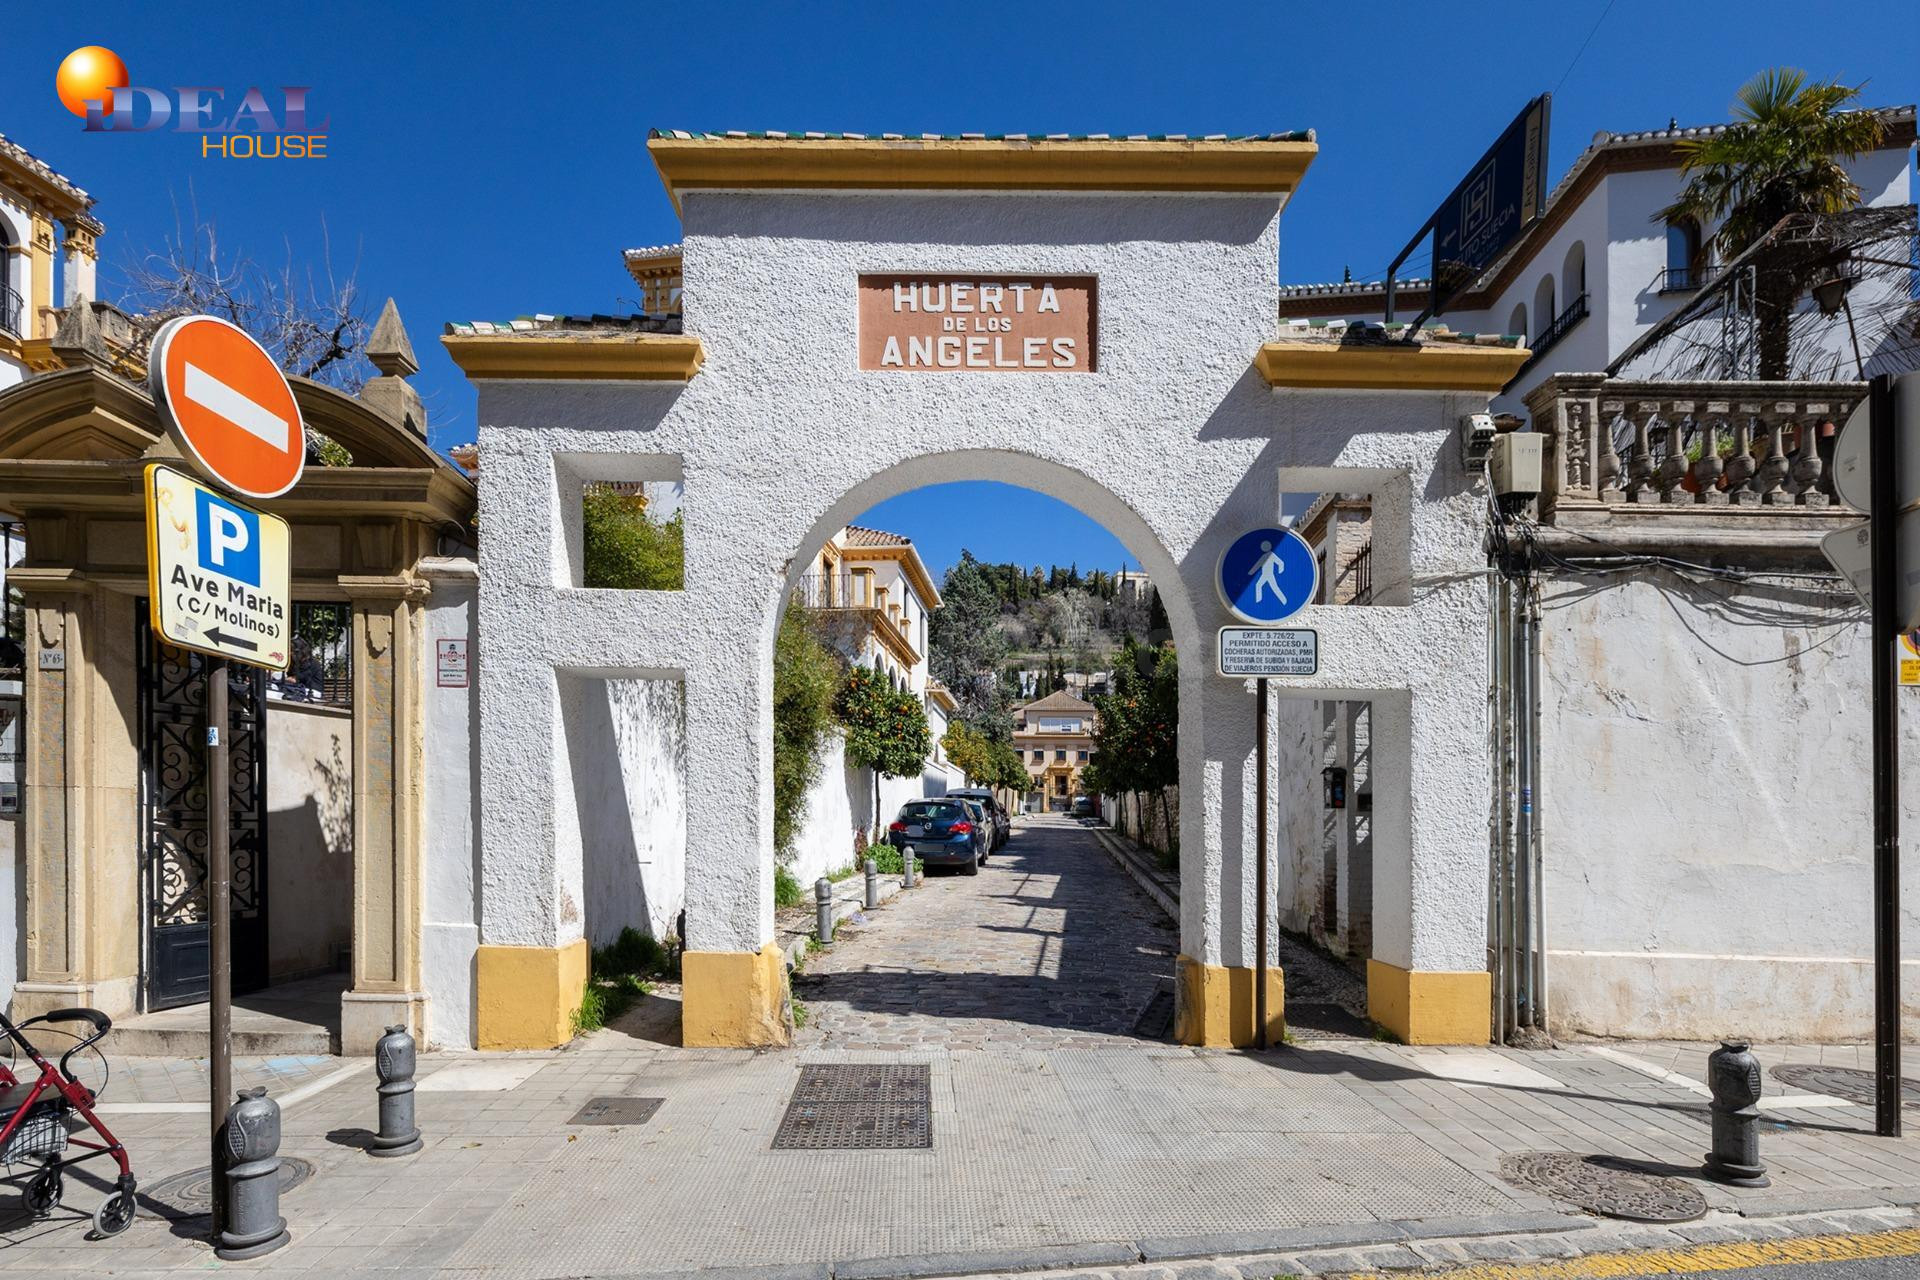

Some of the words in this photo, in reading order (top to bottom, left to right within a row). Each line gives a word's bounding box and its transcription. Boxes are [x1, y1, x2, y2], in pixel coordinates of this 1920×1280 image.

[1481, 203, 1516, 245] SUECIA
[893, 281, 1060, 313] HUERTA
[943, 317, 967, 332] DE
[974, 317, 1012, 332] LOS
[880, 335, 1076, 368] ANGELES
[208, 502, 249, 567] P
[171, 564, 219, 598] Ave
[228, 582, 283, 619] Maria
[1224, 648, 1255, 656] COCHERAS
[1299, 648, 1313, 656] PMR
[1272, 640, 1301, 648] ACCESO
[1302, 640, 1308, 648] A
[1229, 656, 1255, 664] RESERVA
[1291, 657, 1313, 665] BAJADA
[1291, 665, 1313, 673] SUECIA
